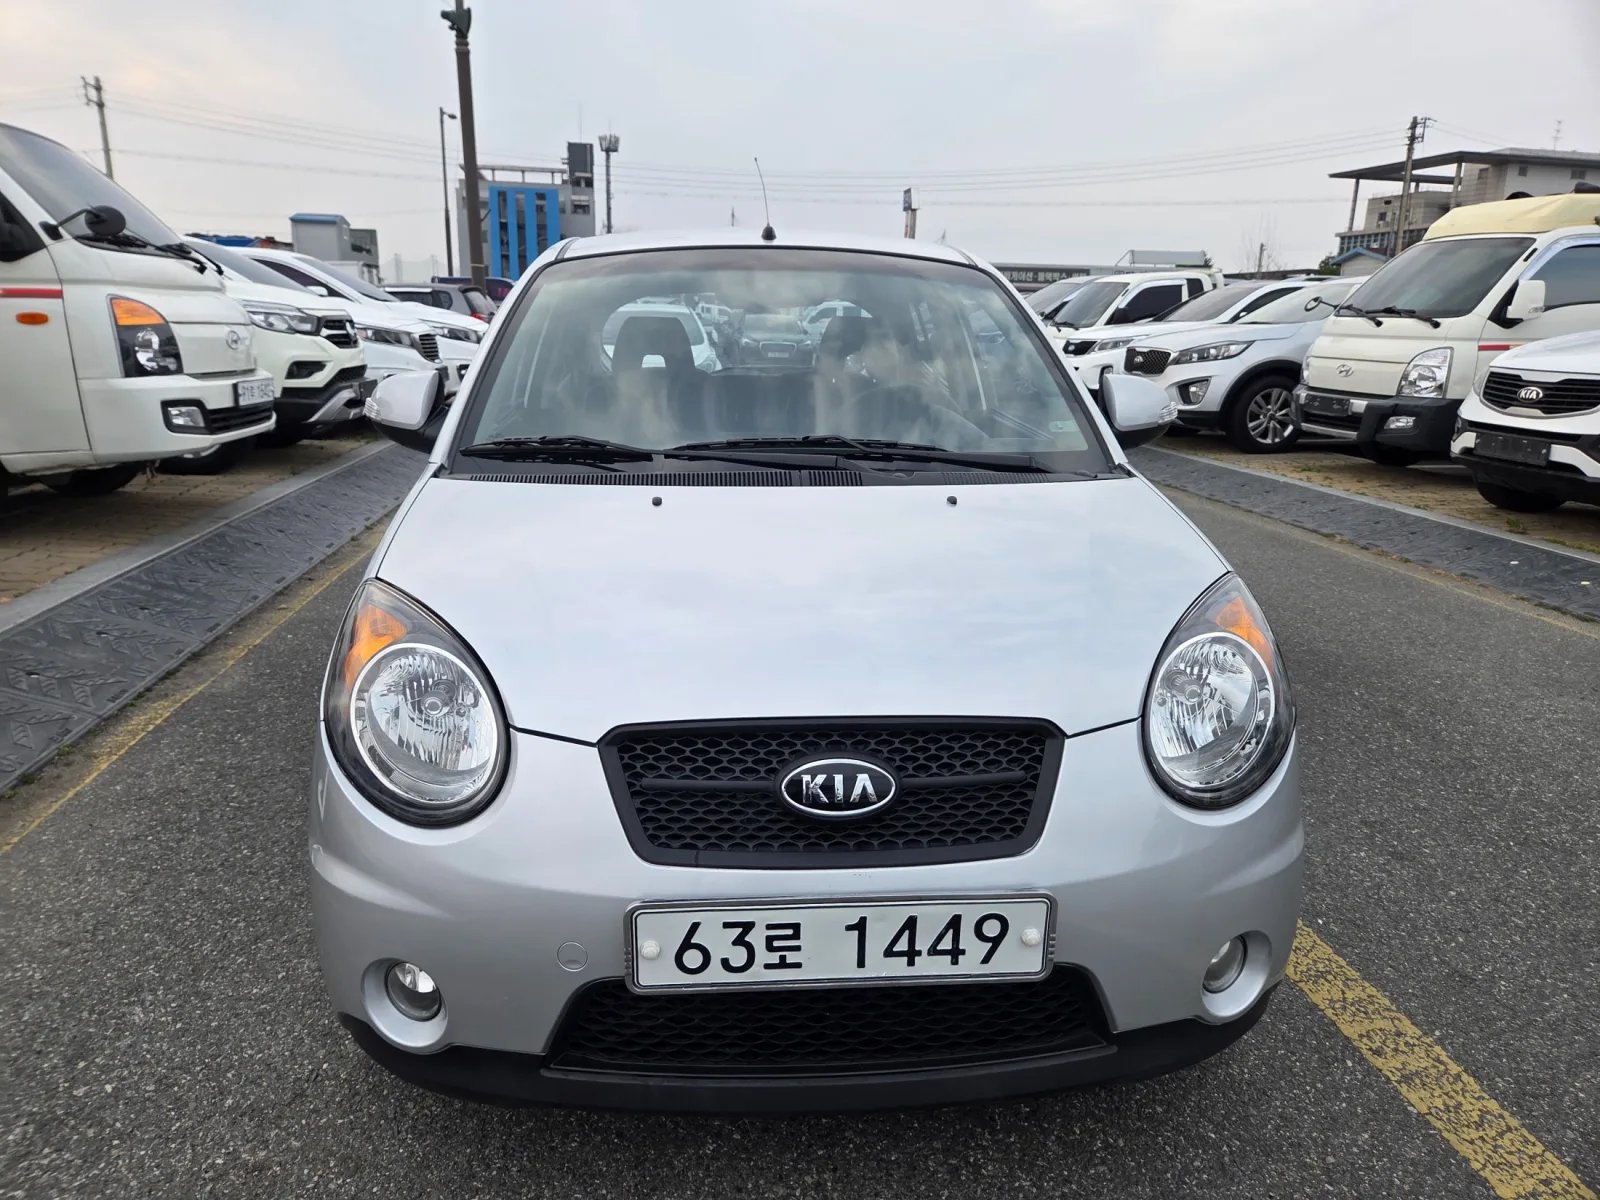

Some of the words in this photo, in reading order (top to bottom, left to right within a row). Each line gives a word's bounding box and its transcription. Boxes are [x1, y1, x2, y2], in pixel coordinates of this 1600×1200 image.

[1519, 389, 1537, 400] KIA
[801, 773, 878, 804] KIA
[674, 921, 803, 975] 63로
[844, 913, 1010, 969] 1449
